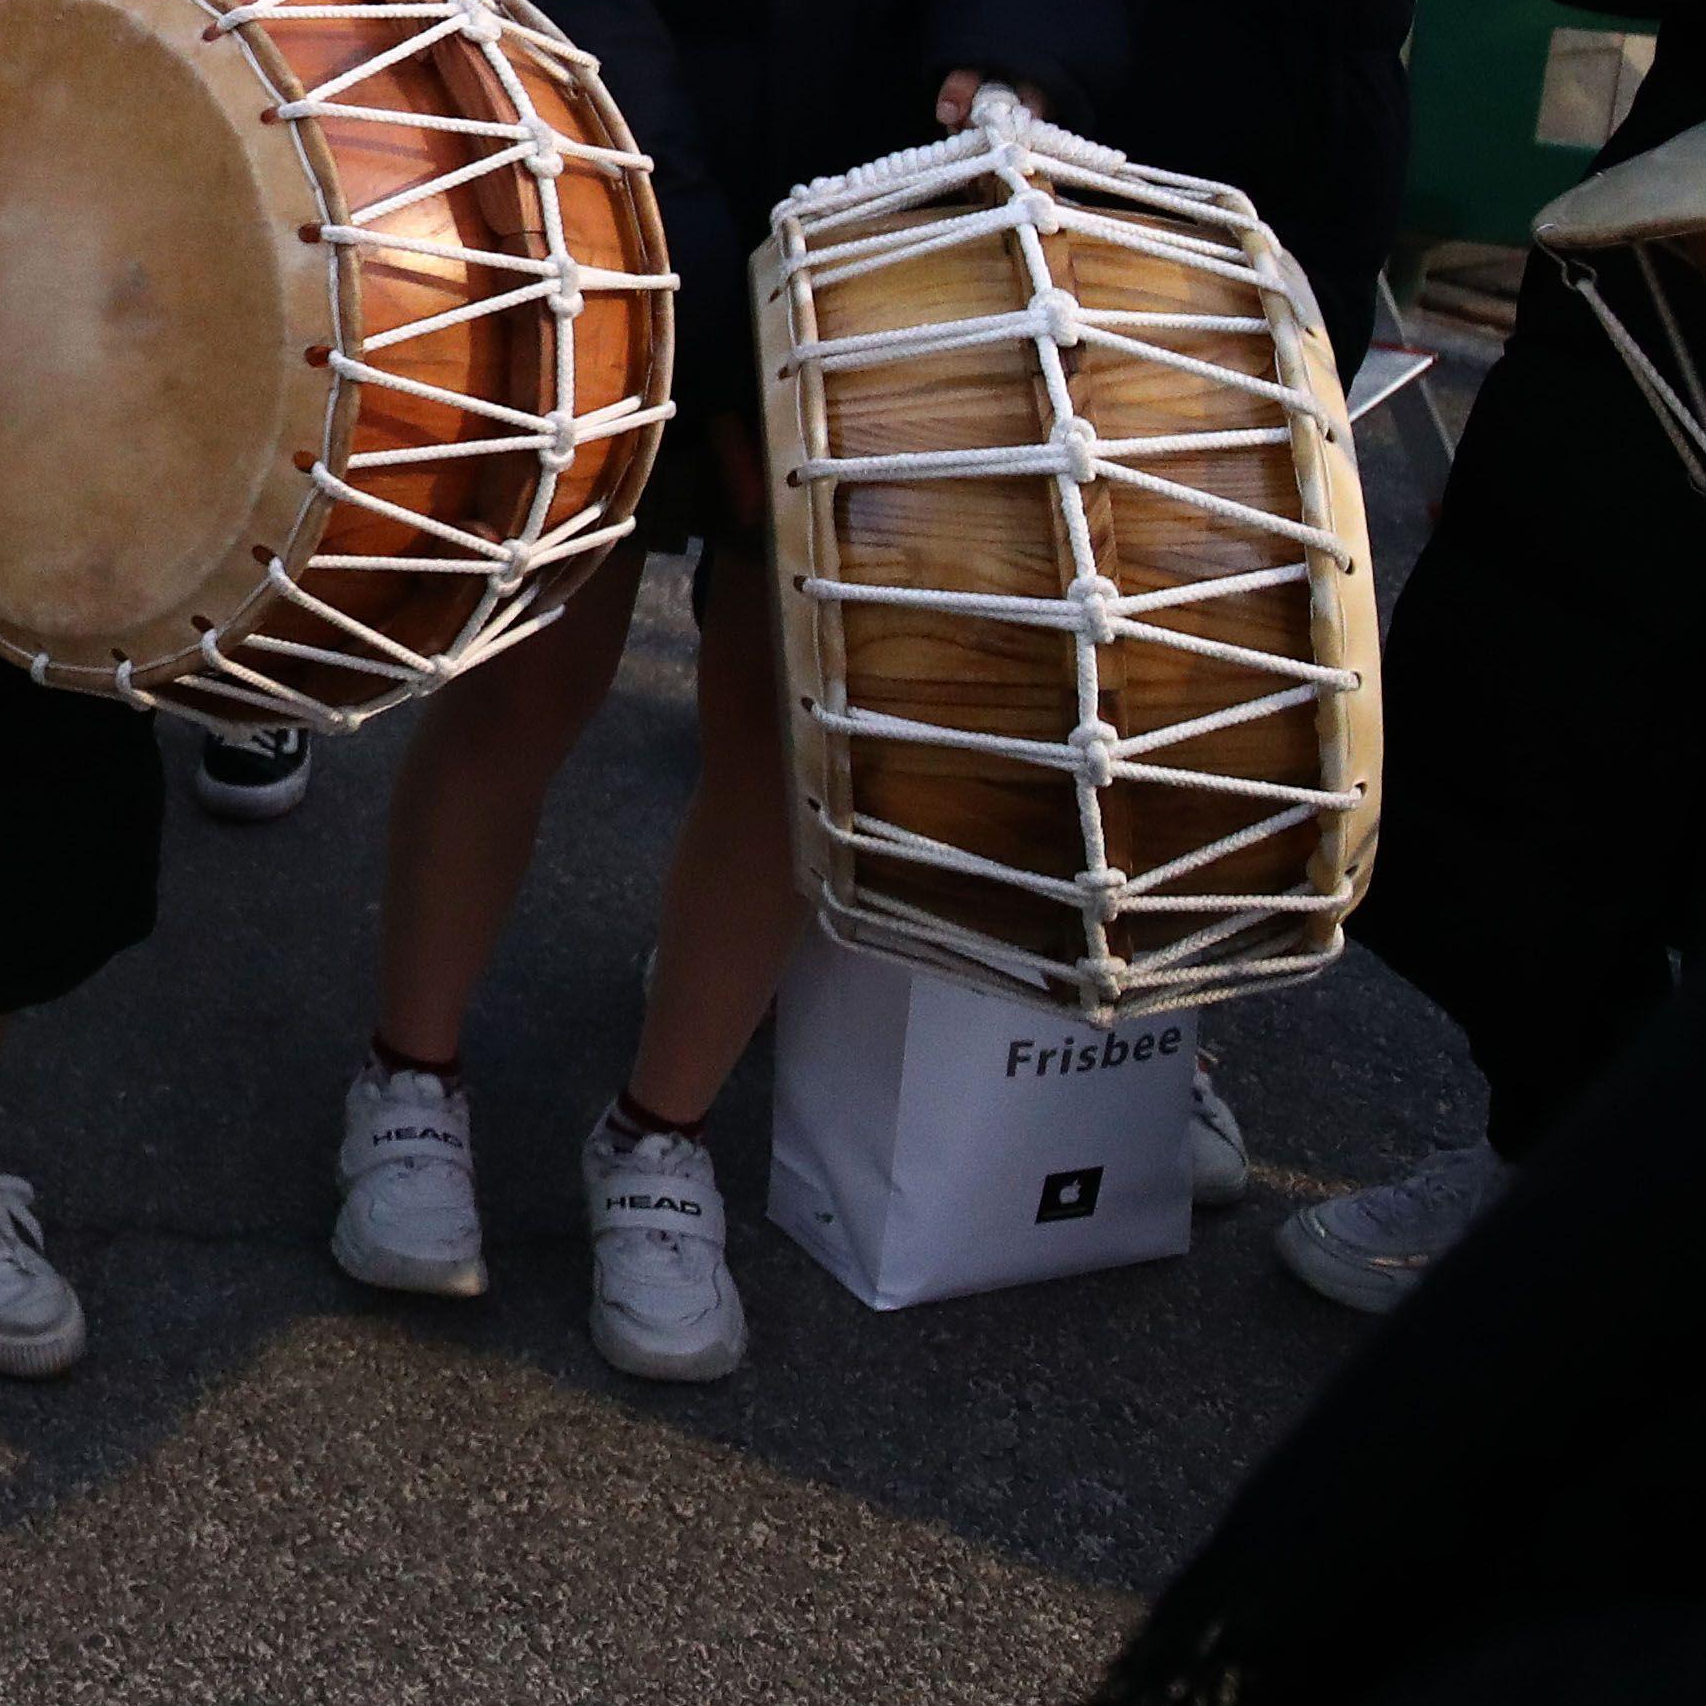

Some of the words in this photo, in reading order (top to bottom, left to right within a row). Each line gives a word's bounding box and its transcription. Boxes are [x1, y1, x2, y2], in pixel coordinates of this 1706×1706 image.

[1005, 1025, 1183, 1078] Frisbee
[372, 1125, 463, 1149] HEAD
[606, 1194, 702, 1217] HEAD
